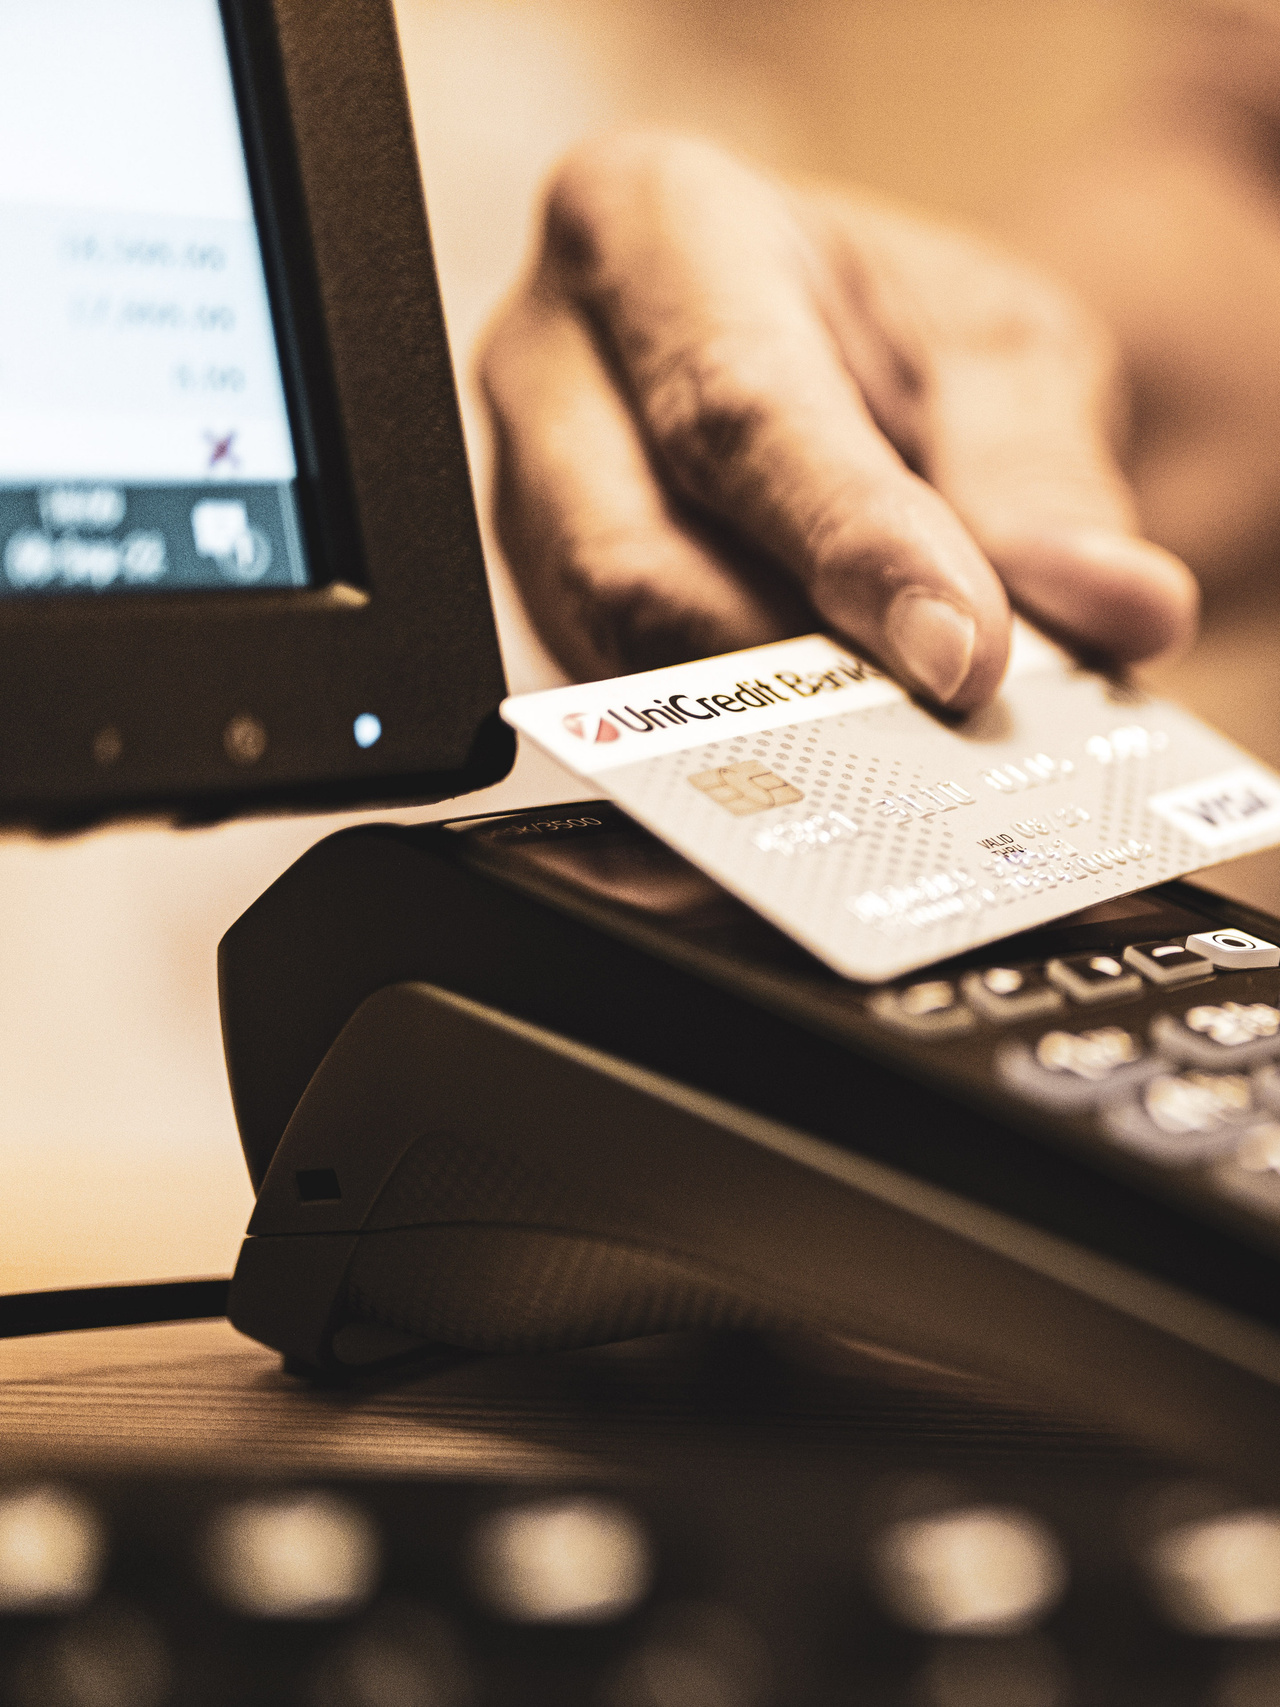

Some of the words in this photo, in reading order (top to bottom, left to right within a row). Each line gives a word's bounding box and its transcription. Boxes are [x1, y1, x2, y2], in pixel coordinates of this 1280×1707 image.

[607, 680, 790, 733] UniCredit
[774, 659, 880, 698] Bank
[976, 833, 1014, 850] VALID
